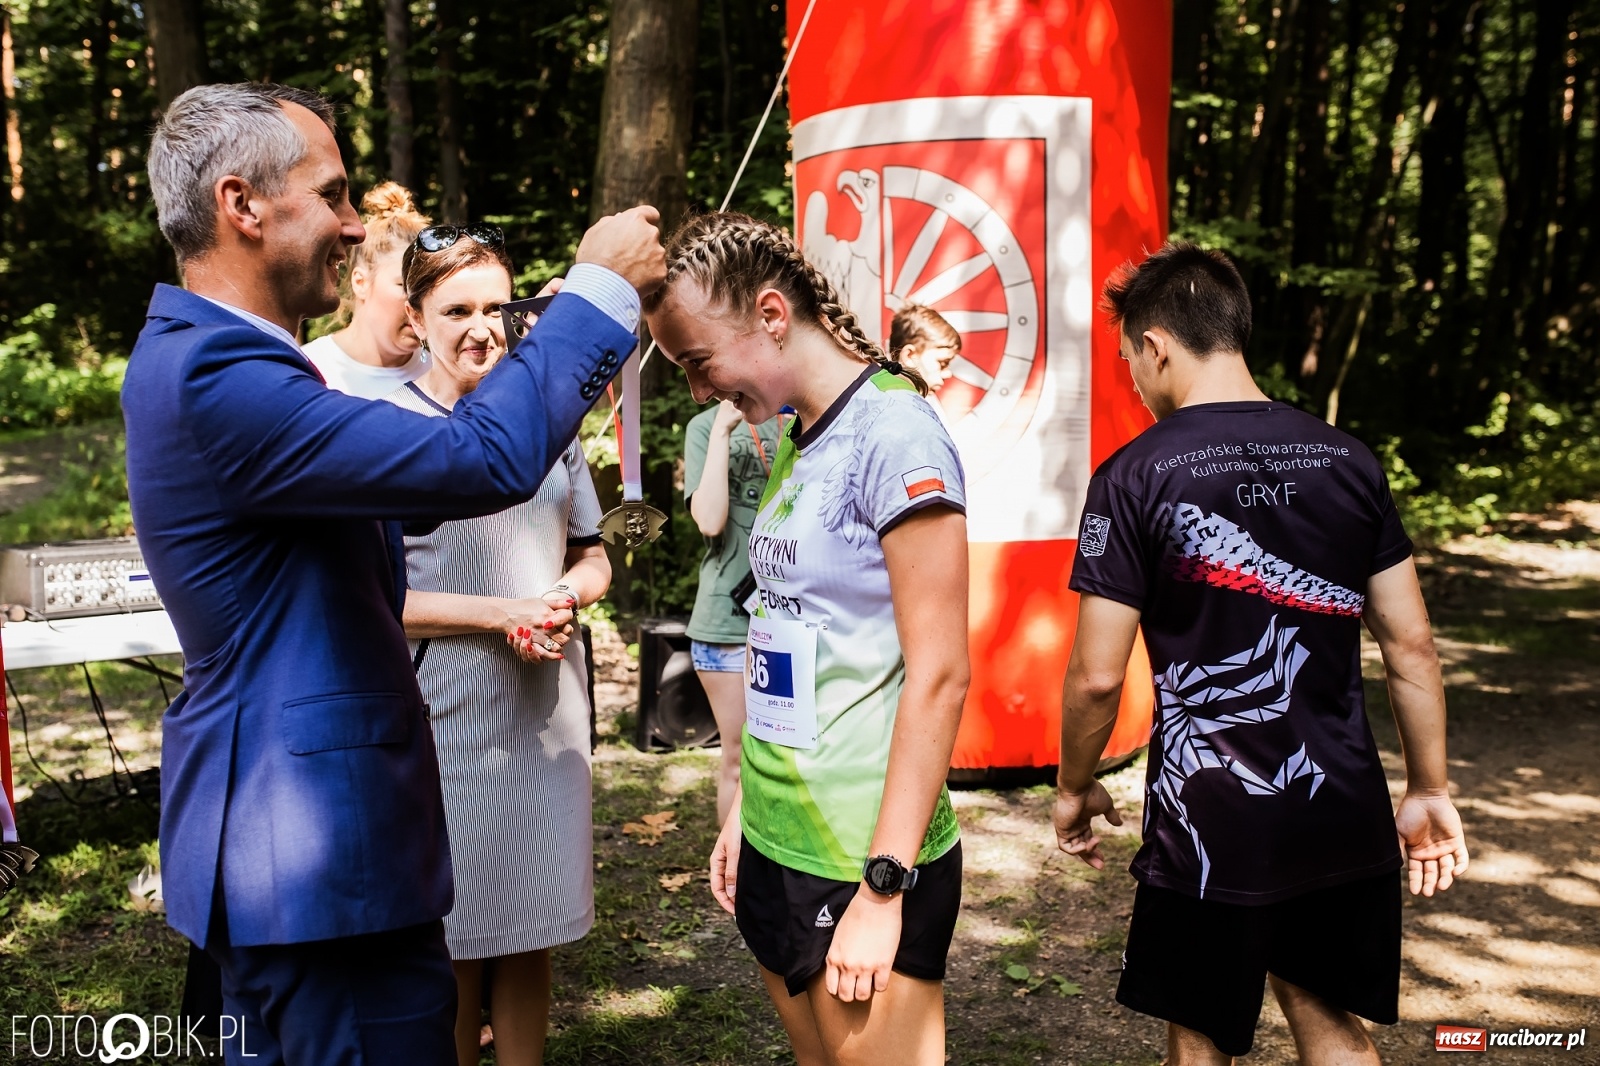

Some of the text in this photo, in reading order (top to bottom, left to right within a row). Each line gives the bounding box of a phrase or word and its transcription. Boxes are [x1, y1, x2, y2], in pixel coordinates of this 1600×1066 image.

[1154, 442, 1350, 474] Kietrzańskie Stowarzyszenie
[1190, 456, 1332, 478] Kulturalno-Sportowe
[1236, 482, 1297, 508] GRYF
[754, 560, 786, 580] LYSKI
